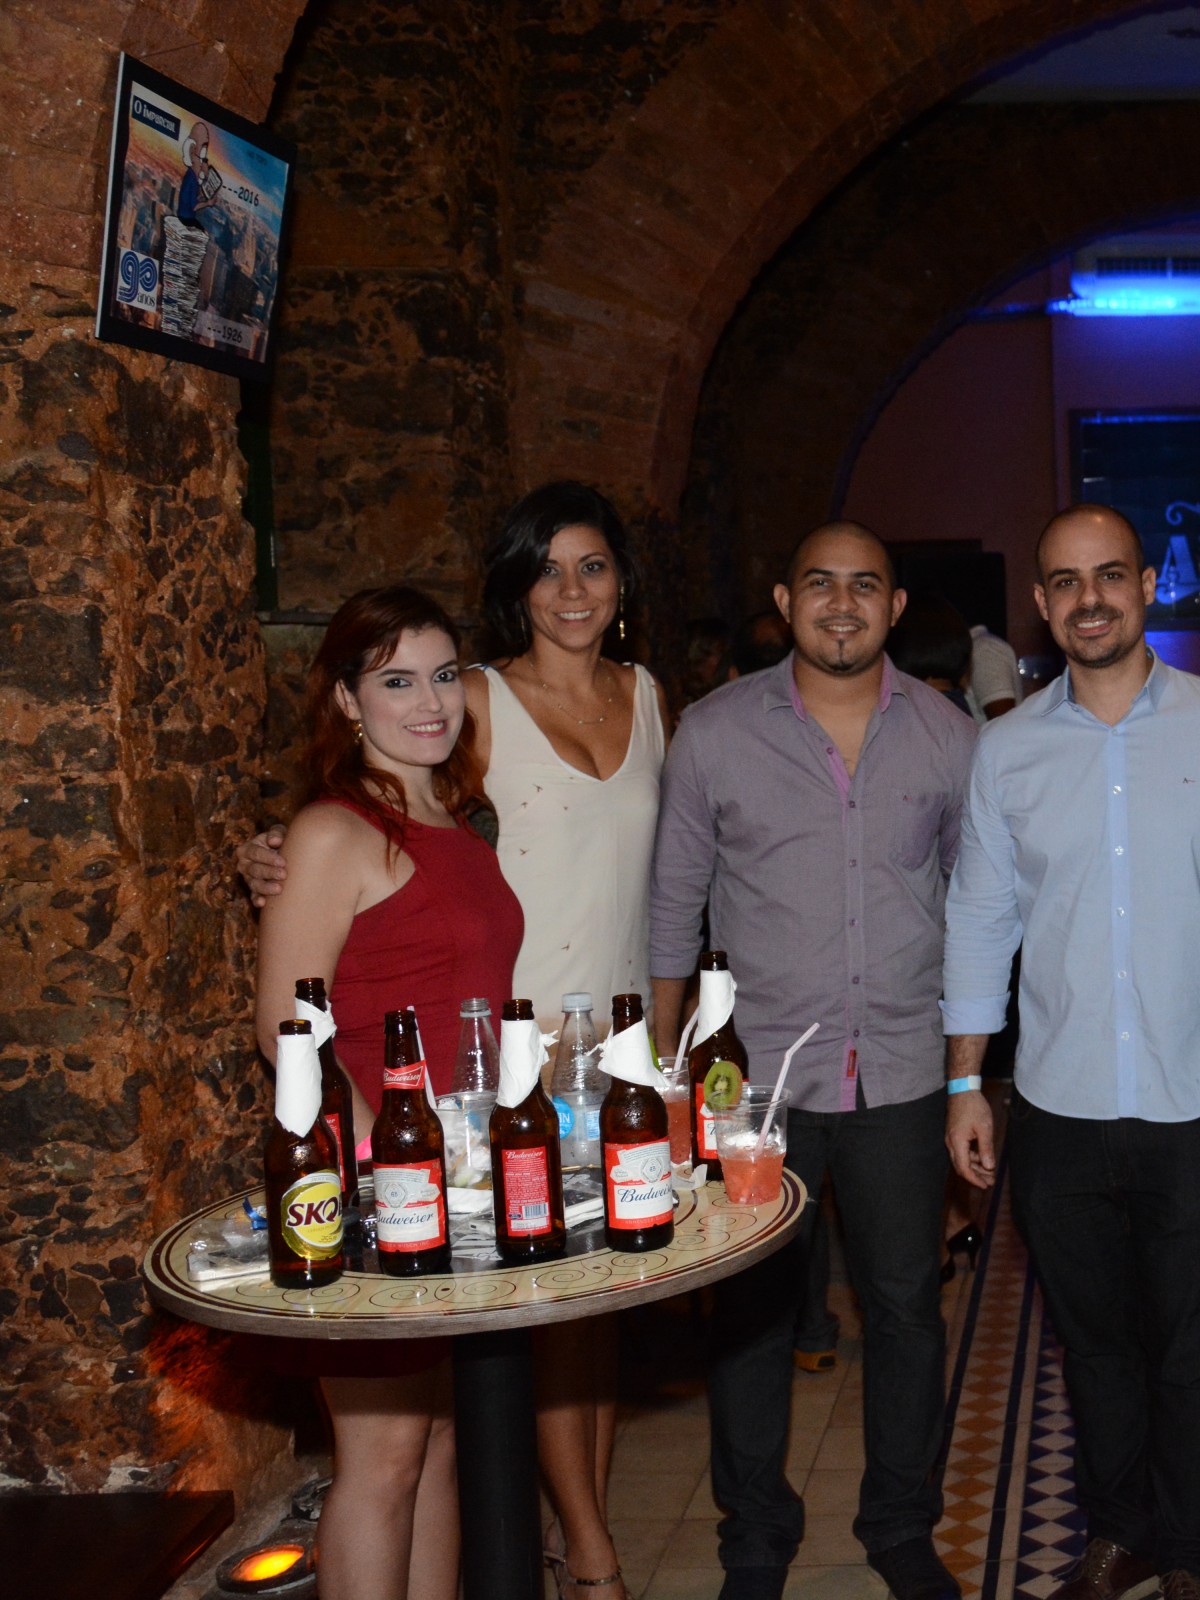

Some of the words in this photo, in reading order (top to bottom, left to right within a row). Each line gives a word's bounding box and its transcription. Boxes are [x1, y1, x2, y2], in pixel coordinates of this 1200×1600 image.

[238, 186, 259, 206] 2016
[118, 251, 157, 303] 90
[222, 325, 242, 343] 1926
[506, 1151, 544, 1159] Budweiser
